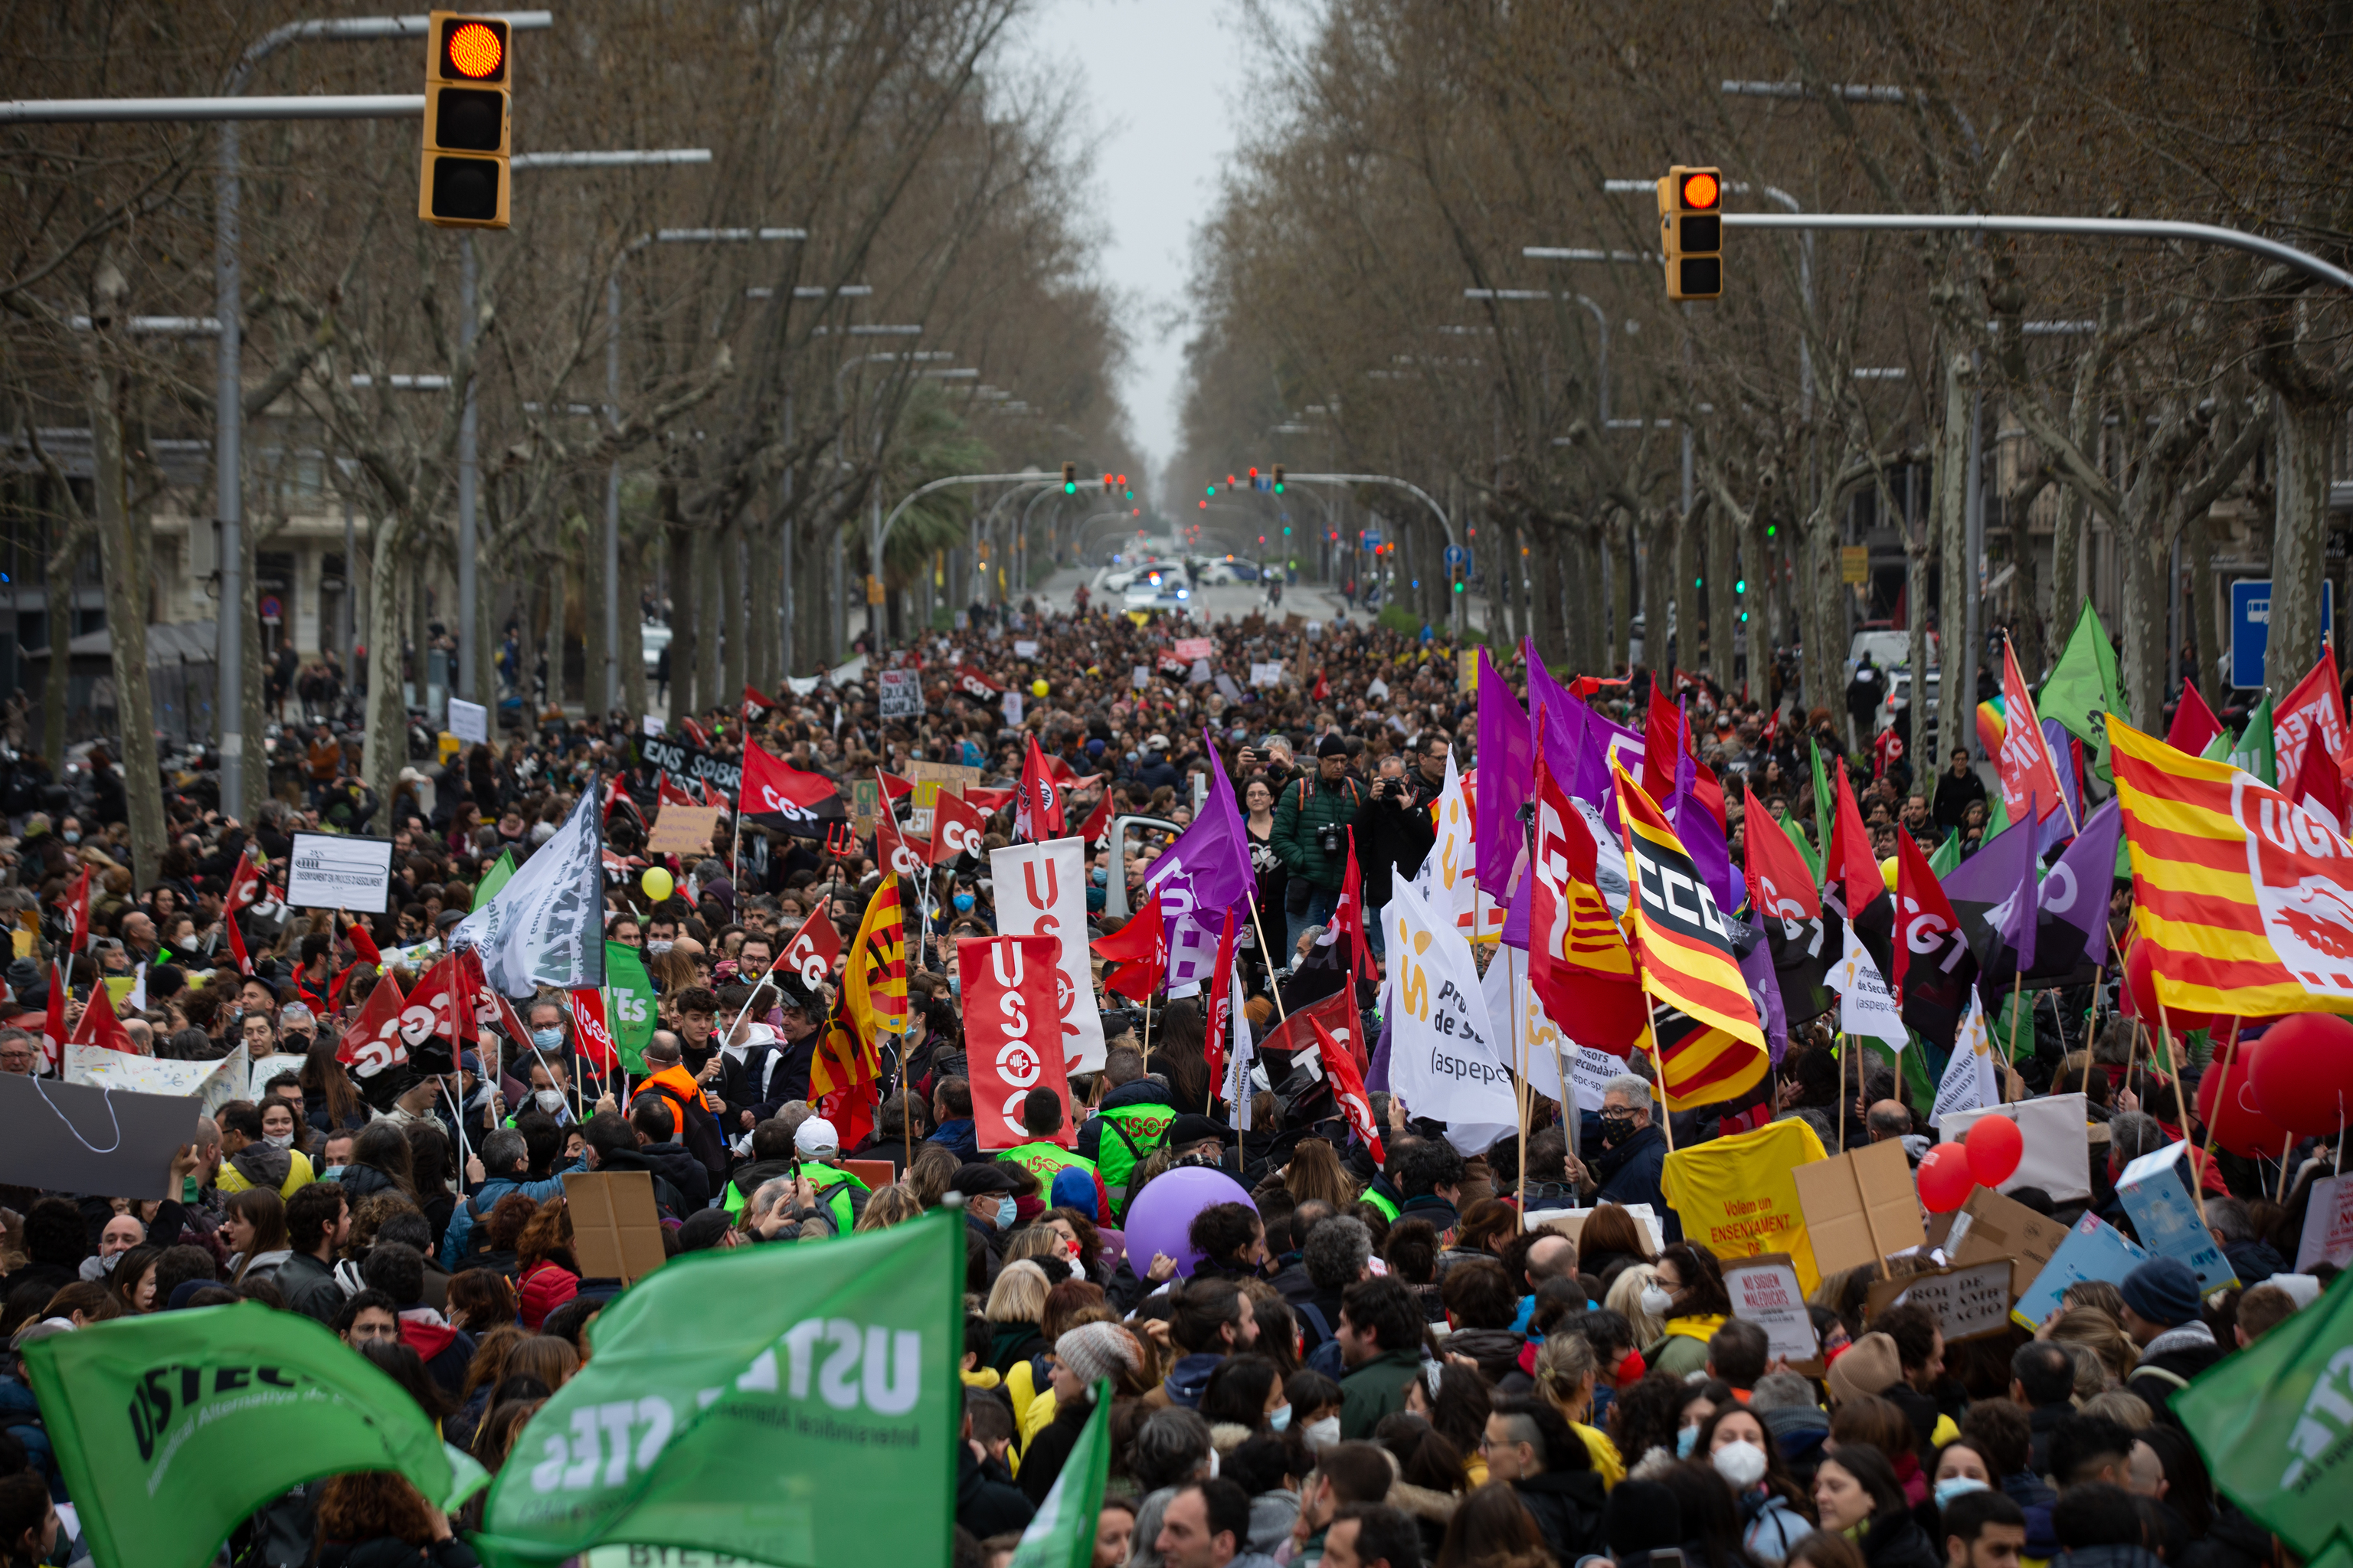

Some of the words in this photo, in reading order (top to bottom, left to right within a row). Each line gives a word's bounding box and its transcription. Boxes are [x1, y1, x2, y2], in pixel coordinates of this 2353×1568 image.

[963, 676, 996, 701] CGT
[642, 739, 686, 771] ENS
[939, 765, 978, 781] MESTRA
[761, 784, 819, 830] CGT
[789, 934, 827, 992] CG
[1857, 979, 1867, 990] de
[1434, 1007, 1455, 1036] de
[1723, 1199, 1756, 1217] Volem
[1758, 1197, 1772, 1210] un
[1710, 1213, 1790, 1244] ENSENYAMENT
[1742, 1275, 1755, 1291] NO
[1752, 1272, 1782, 1290] SIGUEM
[1959, 1275, 1985, 1290] DE
[1743, 1289, 1790, 1308] MALEDUCATS
[1954, 1287, 1999, 1305] AMB
